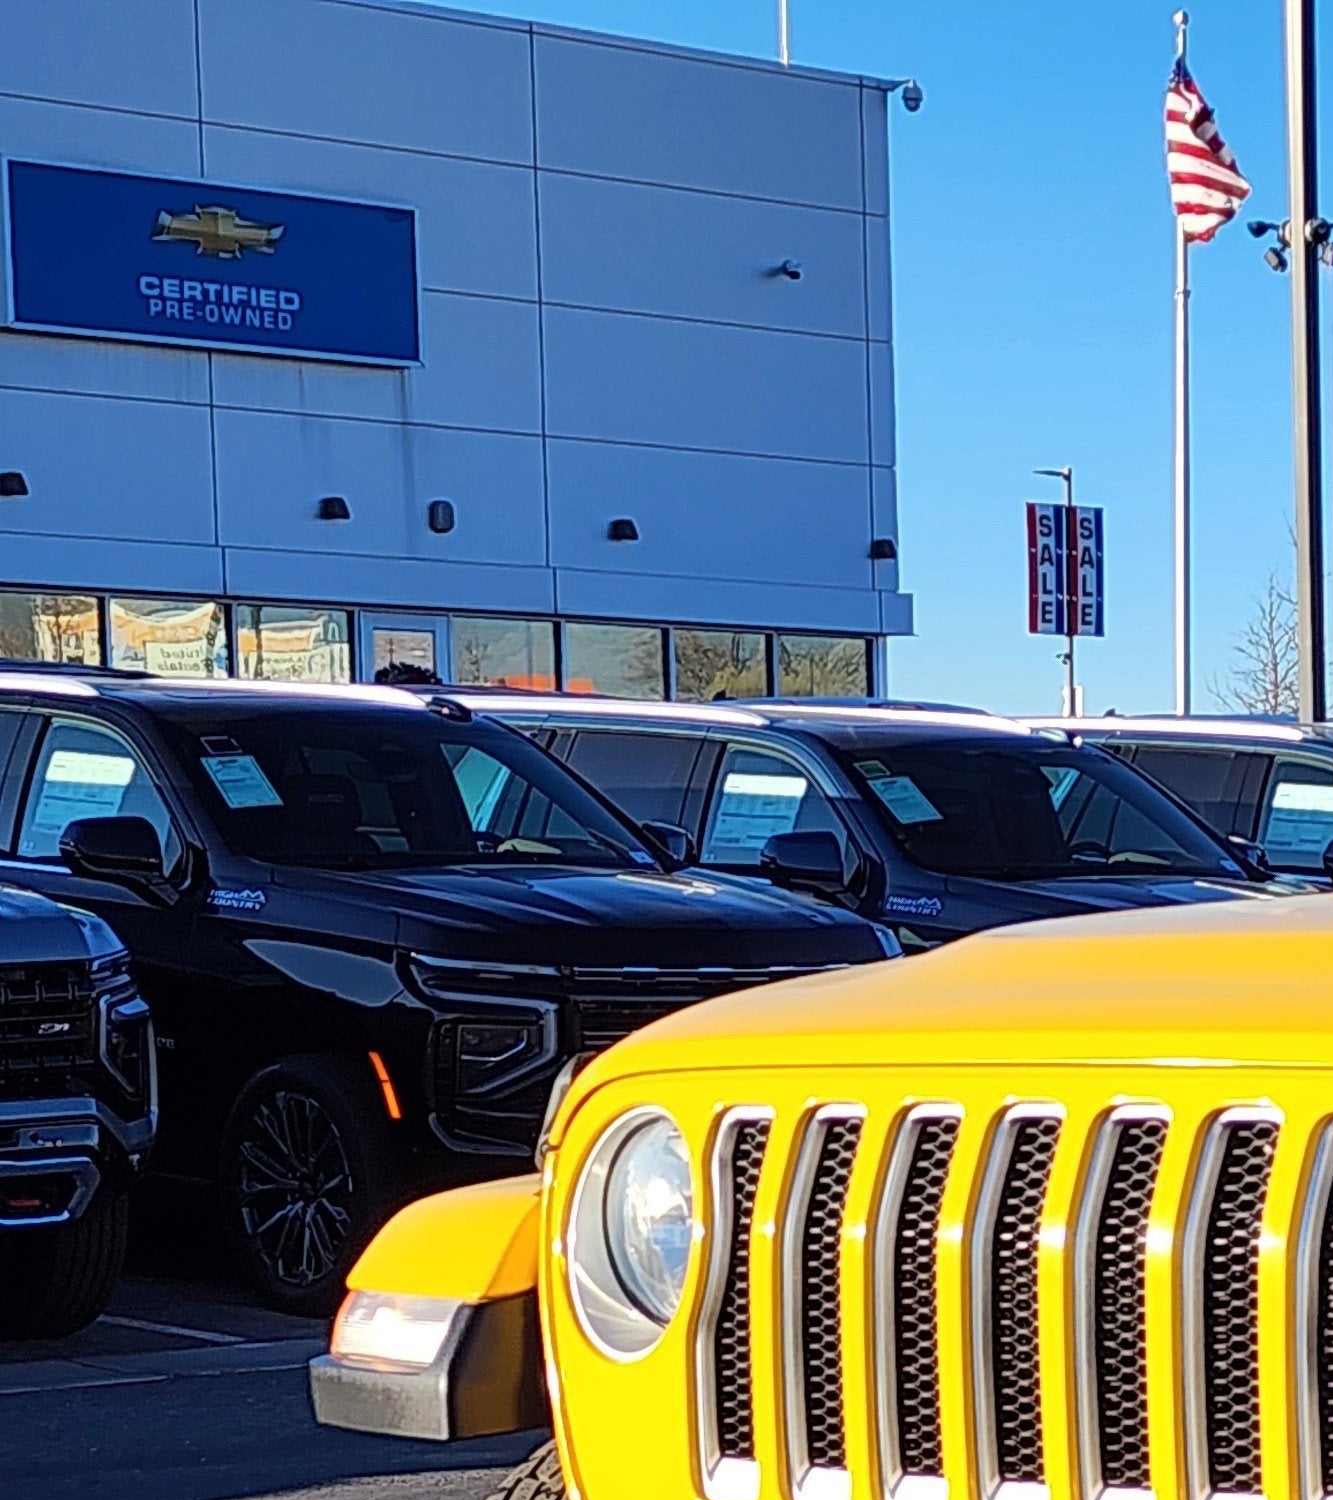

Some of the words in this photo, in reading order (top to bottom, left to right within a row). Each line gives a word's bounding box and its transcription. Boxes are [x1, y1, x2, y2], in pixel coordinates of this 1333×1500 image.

[139, 275, 301, 311] CERTIFIED
[149, 298, 293, 331] PRE-OWNED
[1038, 513, 1055, 625] SALE
[1079, 516, 1096, 627] SALE
